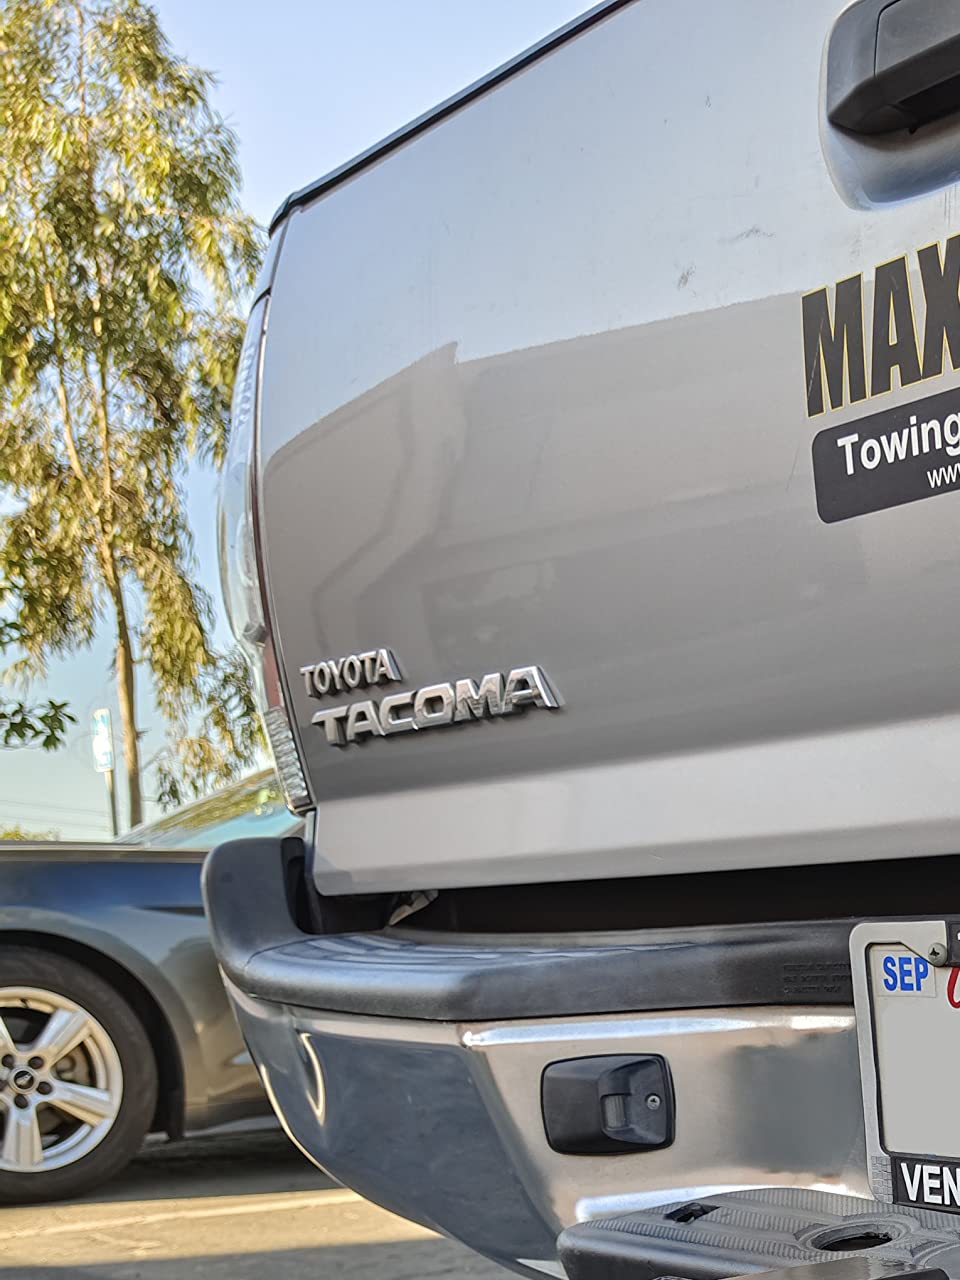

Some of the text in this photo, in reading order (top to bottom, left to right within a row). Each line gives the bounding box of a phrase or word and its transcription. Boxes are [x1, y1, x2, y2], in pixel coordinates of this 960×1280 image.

[300, 648, 402, 698] TOYOTA
[311, 665, 560, 745] TACOMA
[883, 956, 929, 992] SEP
